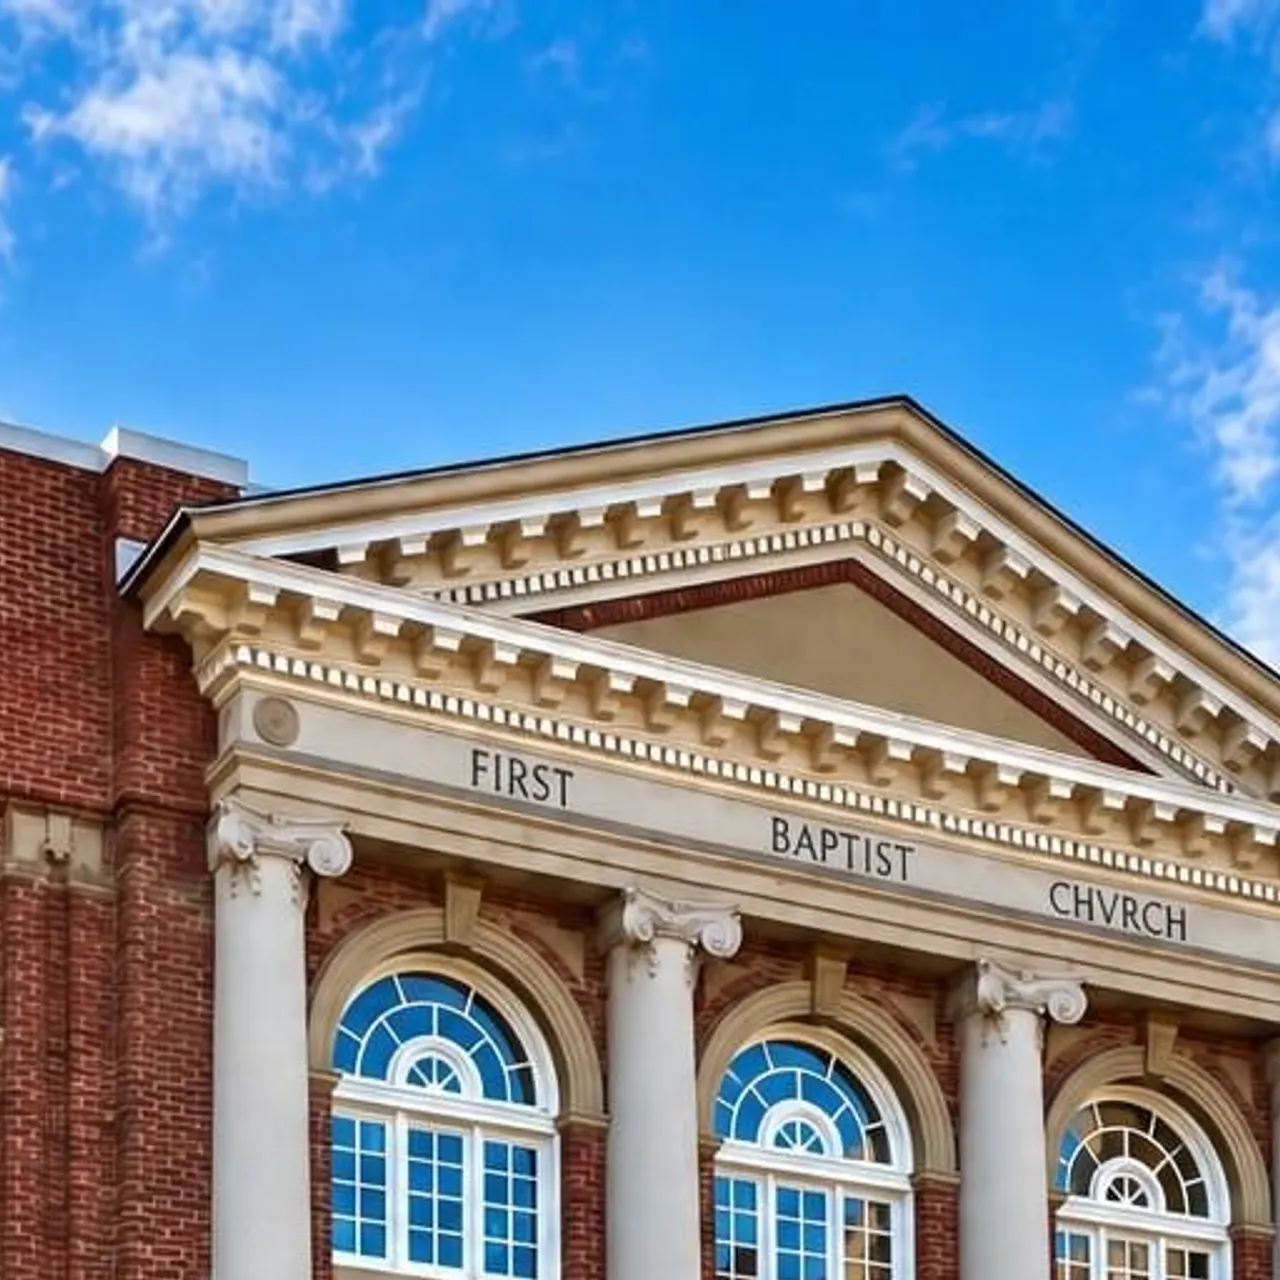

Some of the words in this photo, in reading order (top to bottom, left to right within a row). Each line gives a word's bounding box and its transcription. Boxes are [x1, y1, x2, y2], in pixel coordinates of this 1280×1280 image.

[472, 748, 574, 807] FIRST
[772, 817, 915, 881] BAPTIST
[1050, 881, 1186, 941] CHVRCH
